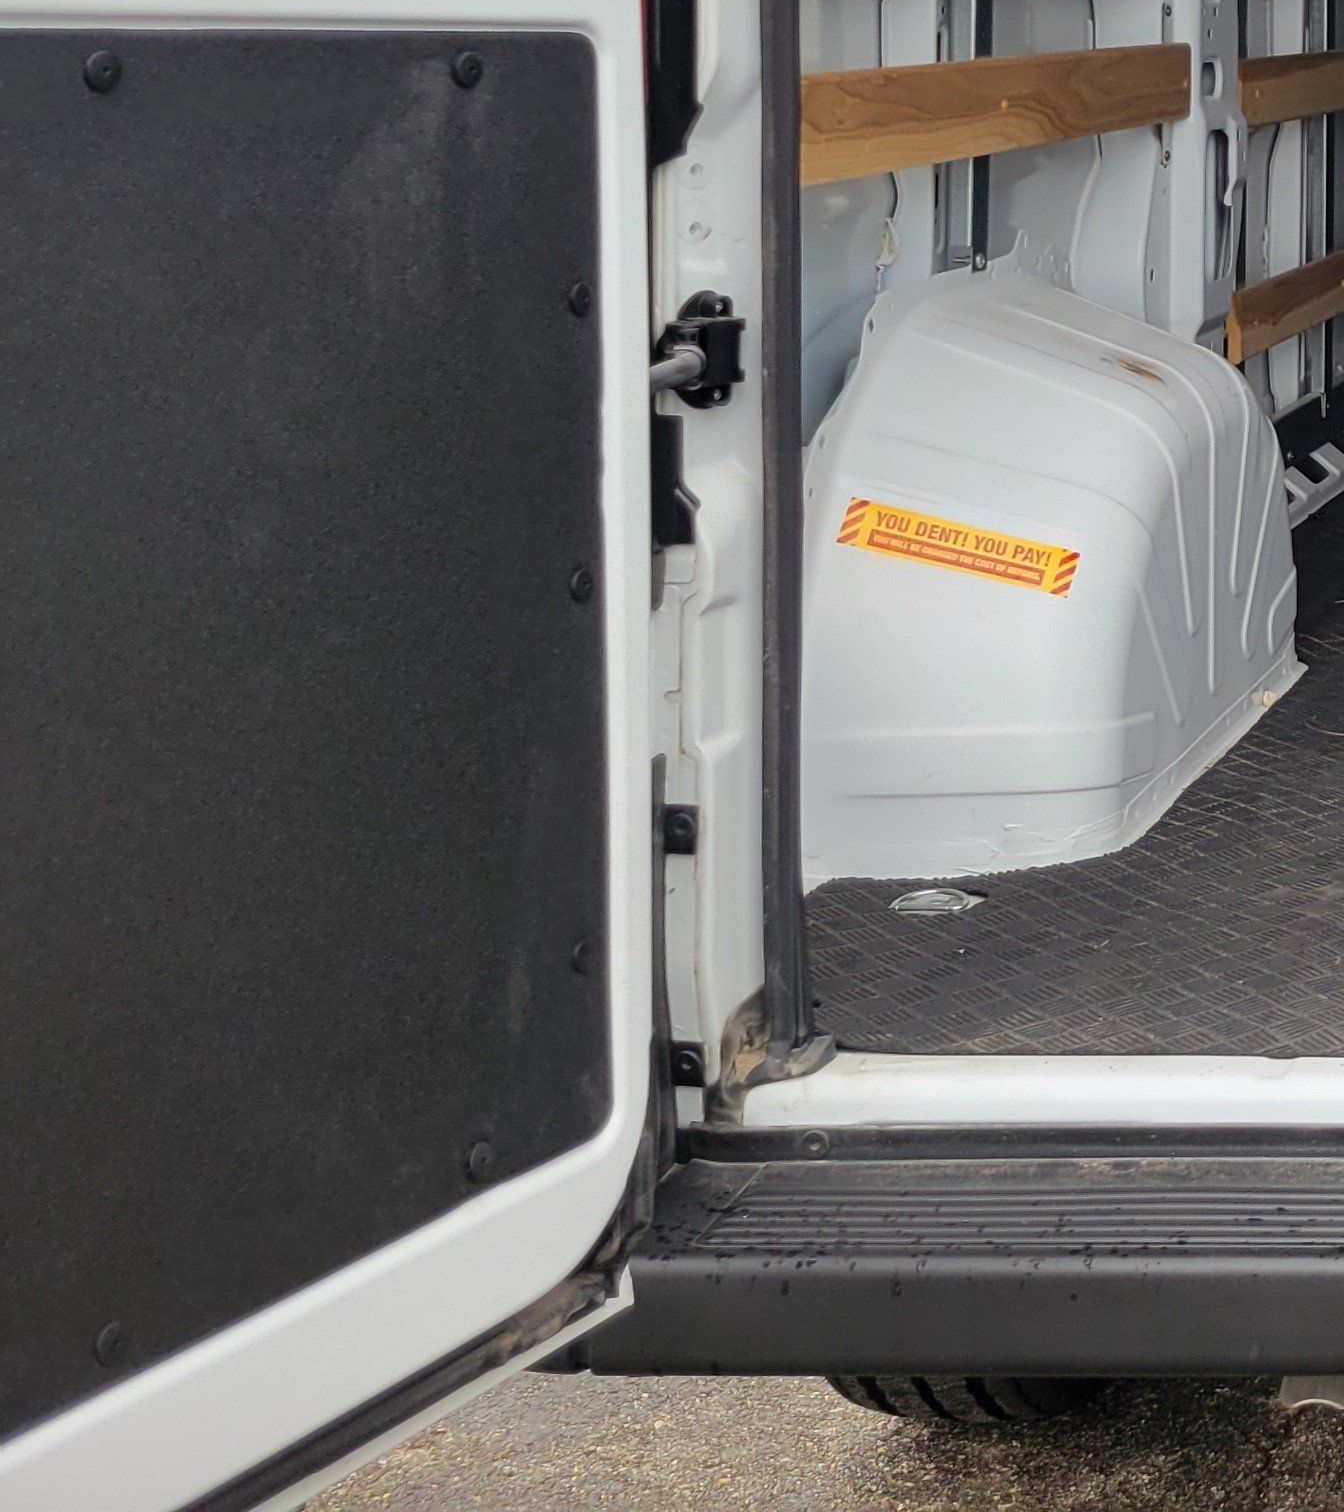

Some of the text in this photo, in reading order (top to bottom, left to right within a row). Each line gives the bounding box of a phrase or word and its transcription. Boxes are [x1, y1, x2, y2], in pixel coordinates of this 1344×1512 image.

[876, 510, 1051, 567] YOU DENT! YOU PAY!
[959, 554, 975, 565] THE
[975, 558, 995, 570] COST
